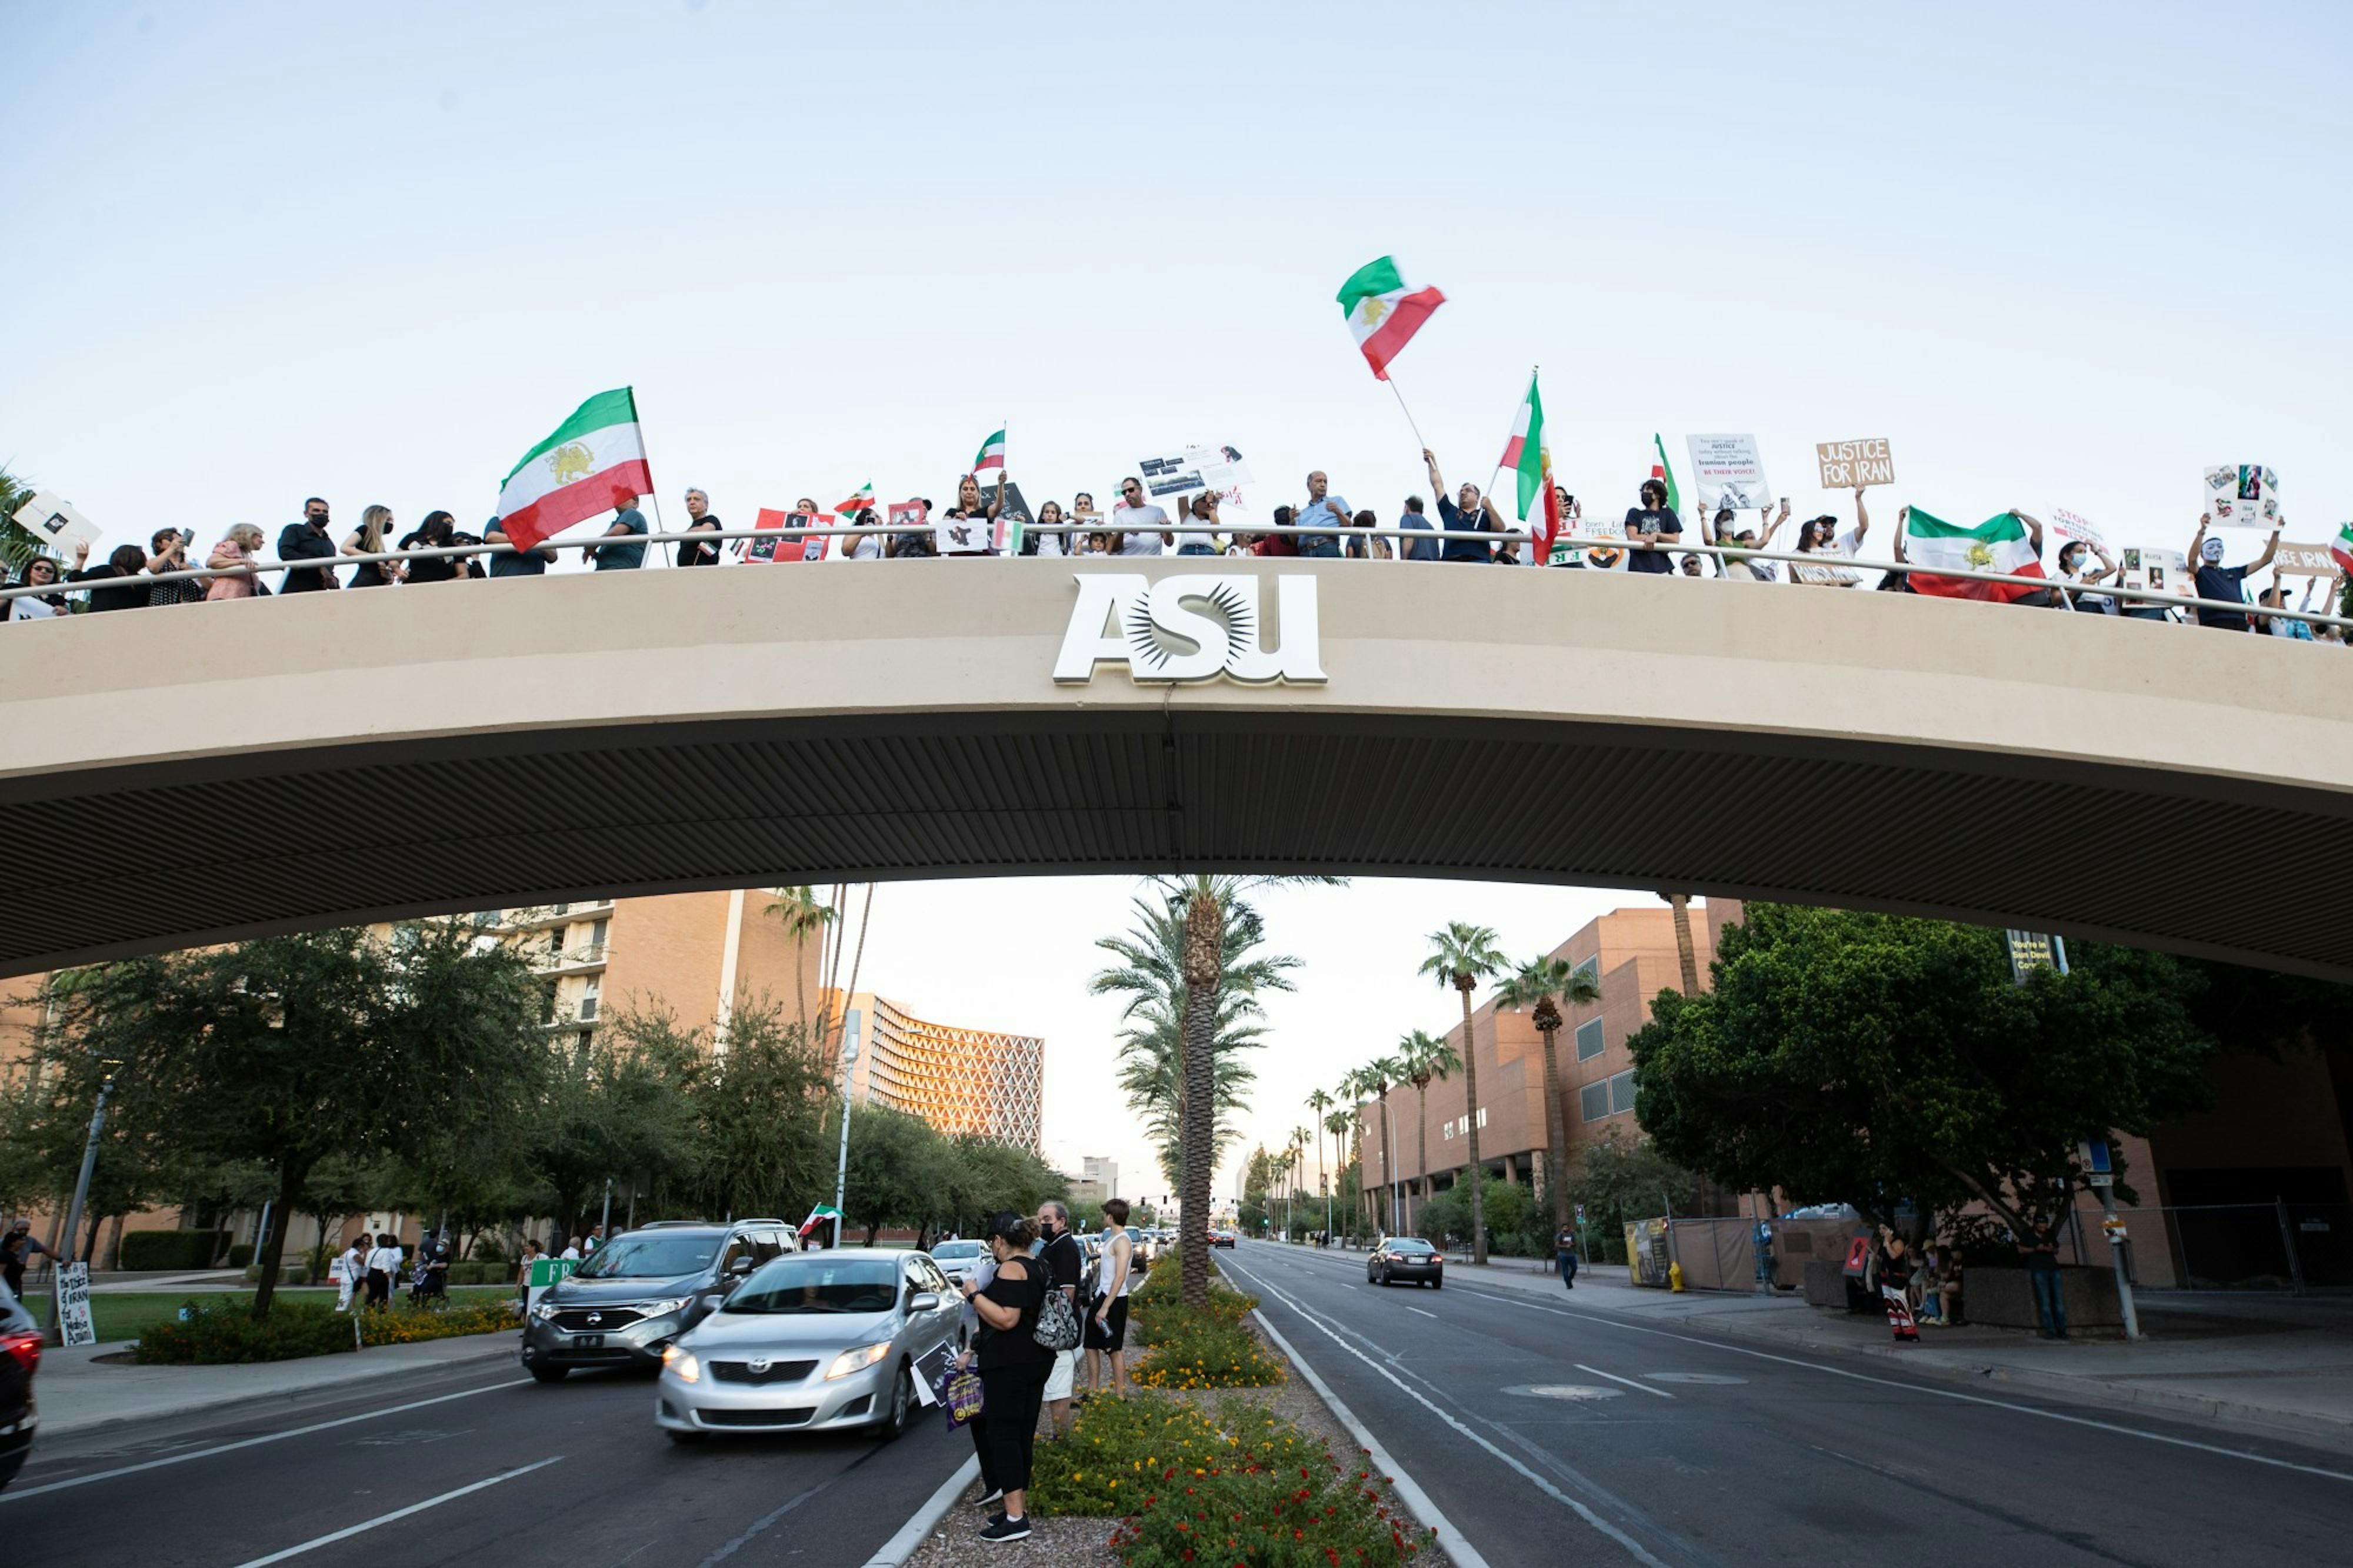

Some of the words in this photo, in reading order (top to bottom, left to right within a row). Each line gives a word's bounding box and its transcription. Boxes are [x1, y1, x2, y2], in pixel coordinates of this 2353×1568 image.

[1820, 440, 1888, 462] JUSTICE
[1824, 462, 1852, 485] FOR
[1855, 459, 1892, 482] IRAN
[2057, 508, 2089, 525] STOP
[1053, 573, 1328, 684] ASU
[2012, 940, 2037, 949] You're
[2013, 951, 2029, 959] Sun
[2031, 950, 2051, 959] Devil
[69, 1289, 88, 1305] IRAN
